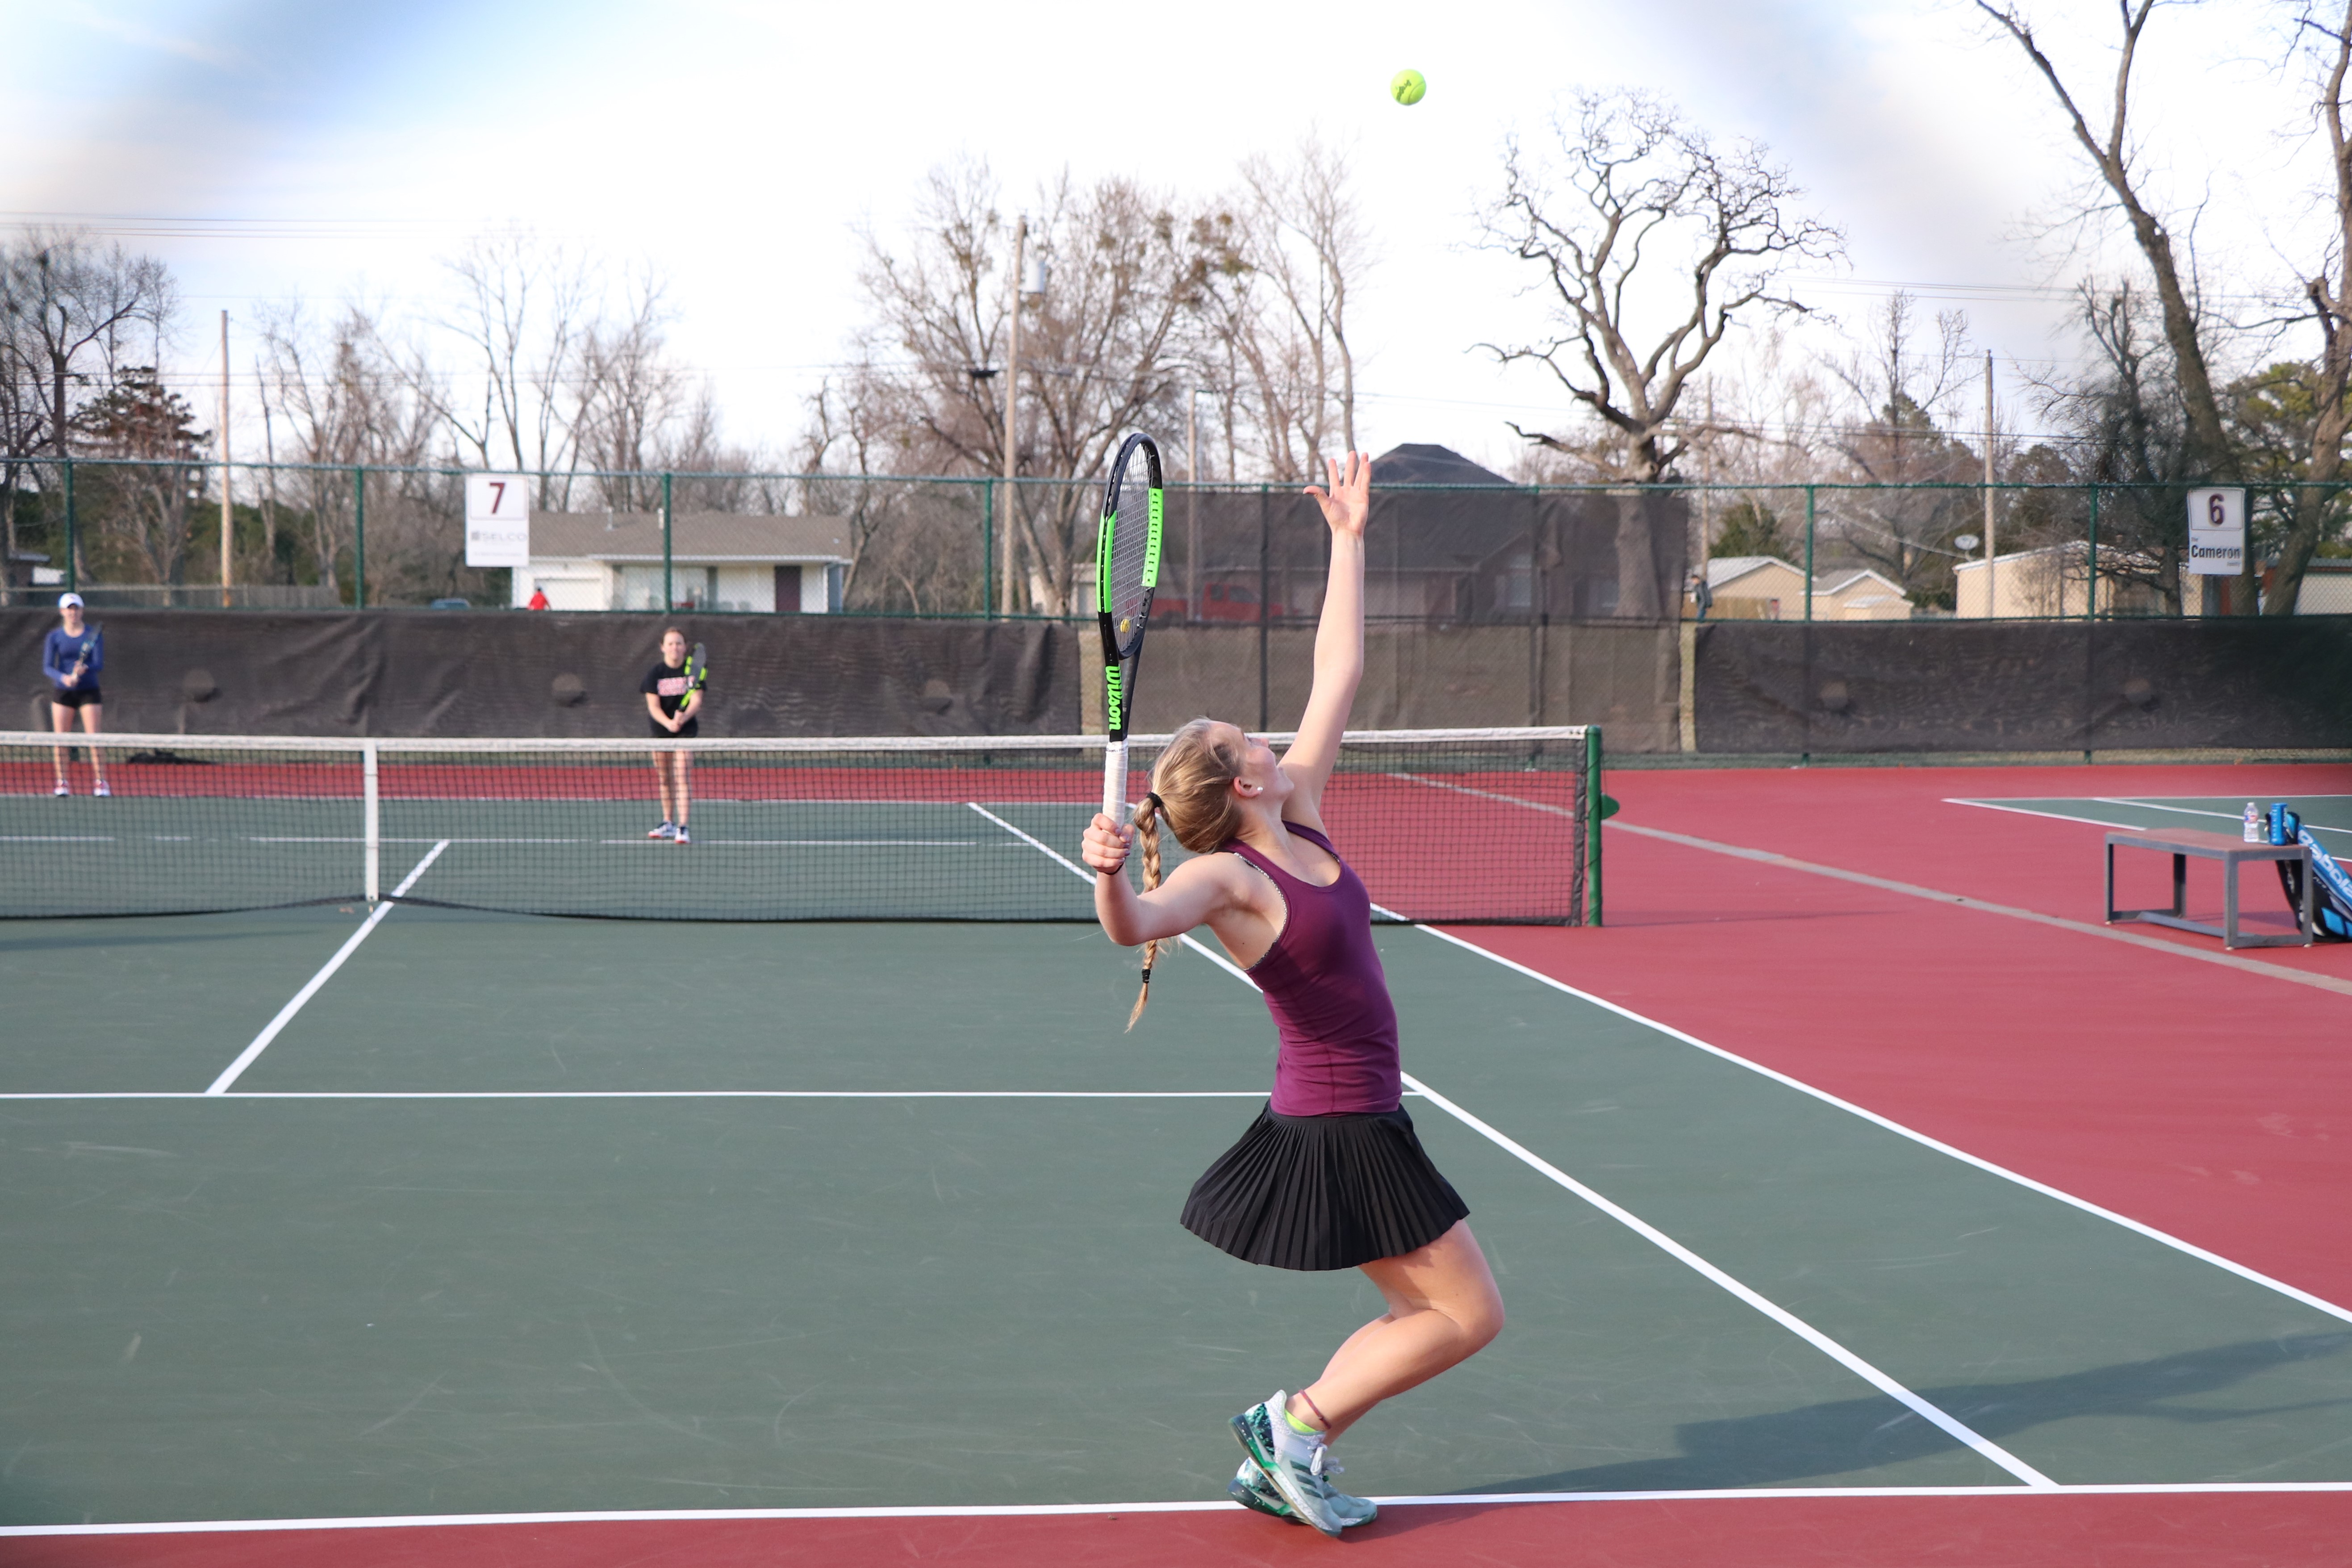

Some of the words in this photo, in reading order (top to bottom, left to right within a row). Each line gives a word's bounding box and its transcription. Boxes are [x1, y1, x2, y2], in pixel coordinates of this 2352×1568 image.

[489, 482, 505, 514] 7
[2209, 493, 2225, 524] 6
[2192, 545, 2240, 558] Cameron
[1105, 665, 1123, 730] Wilson
